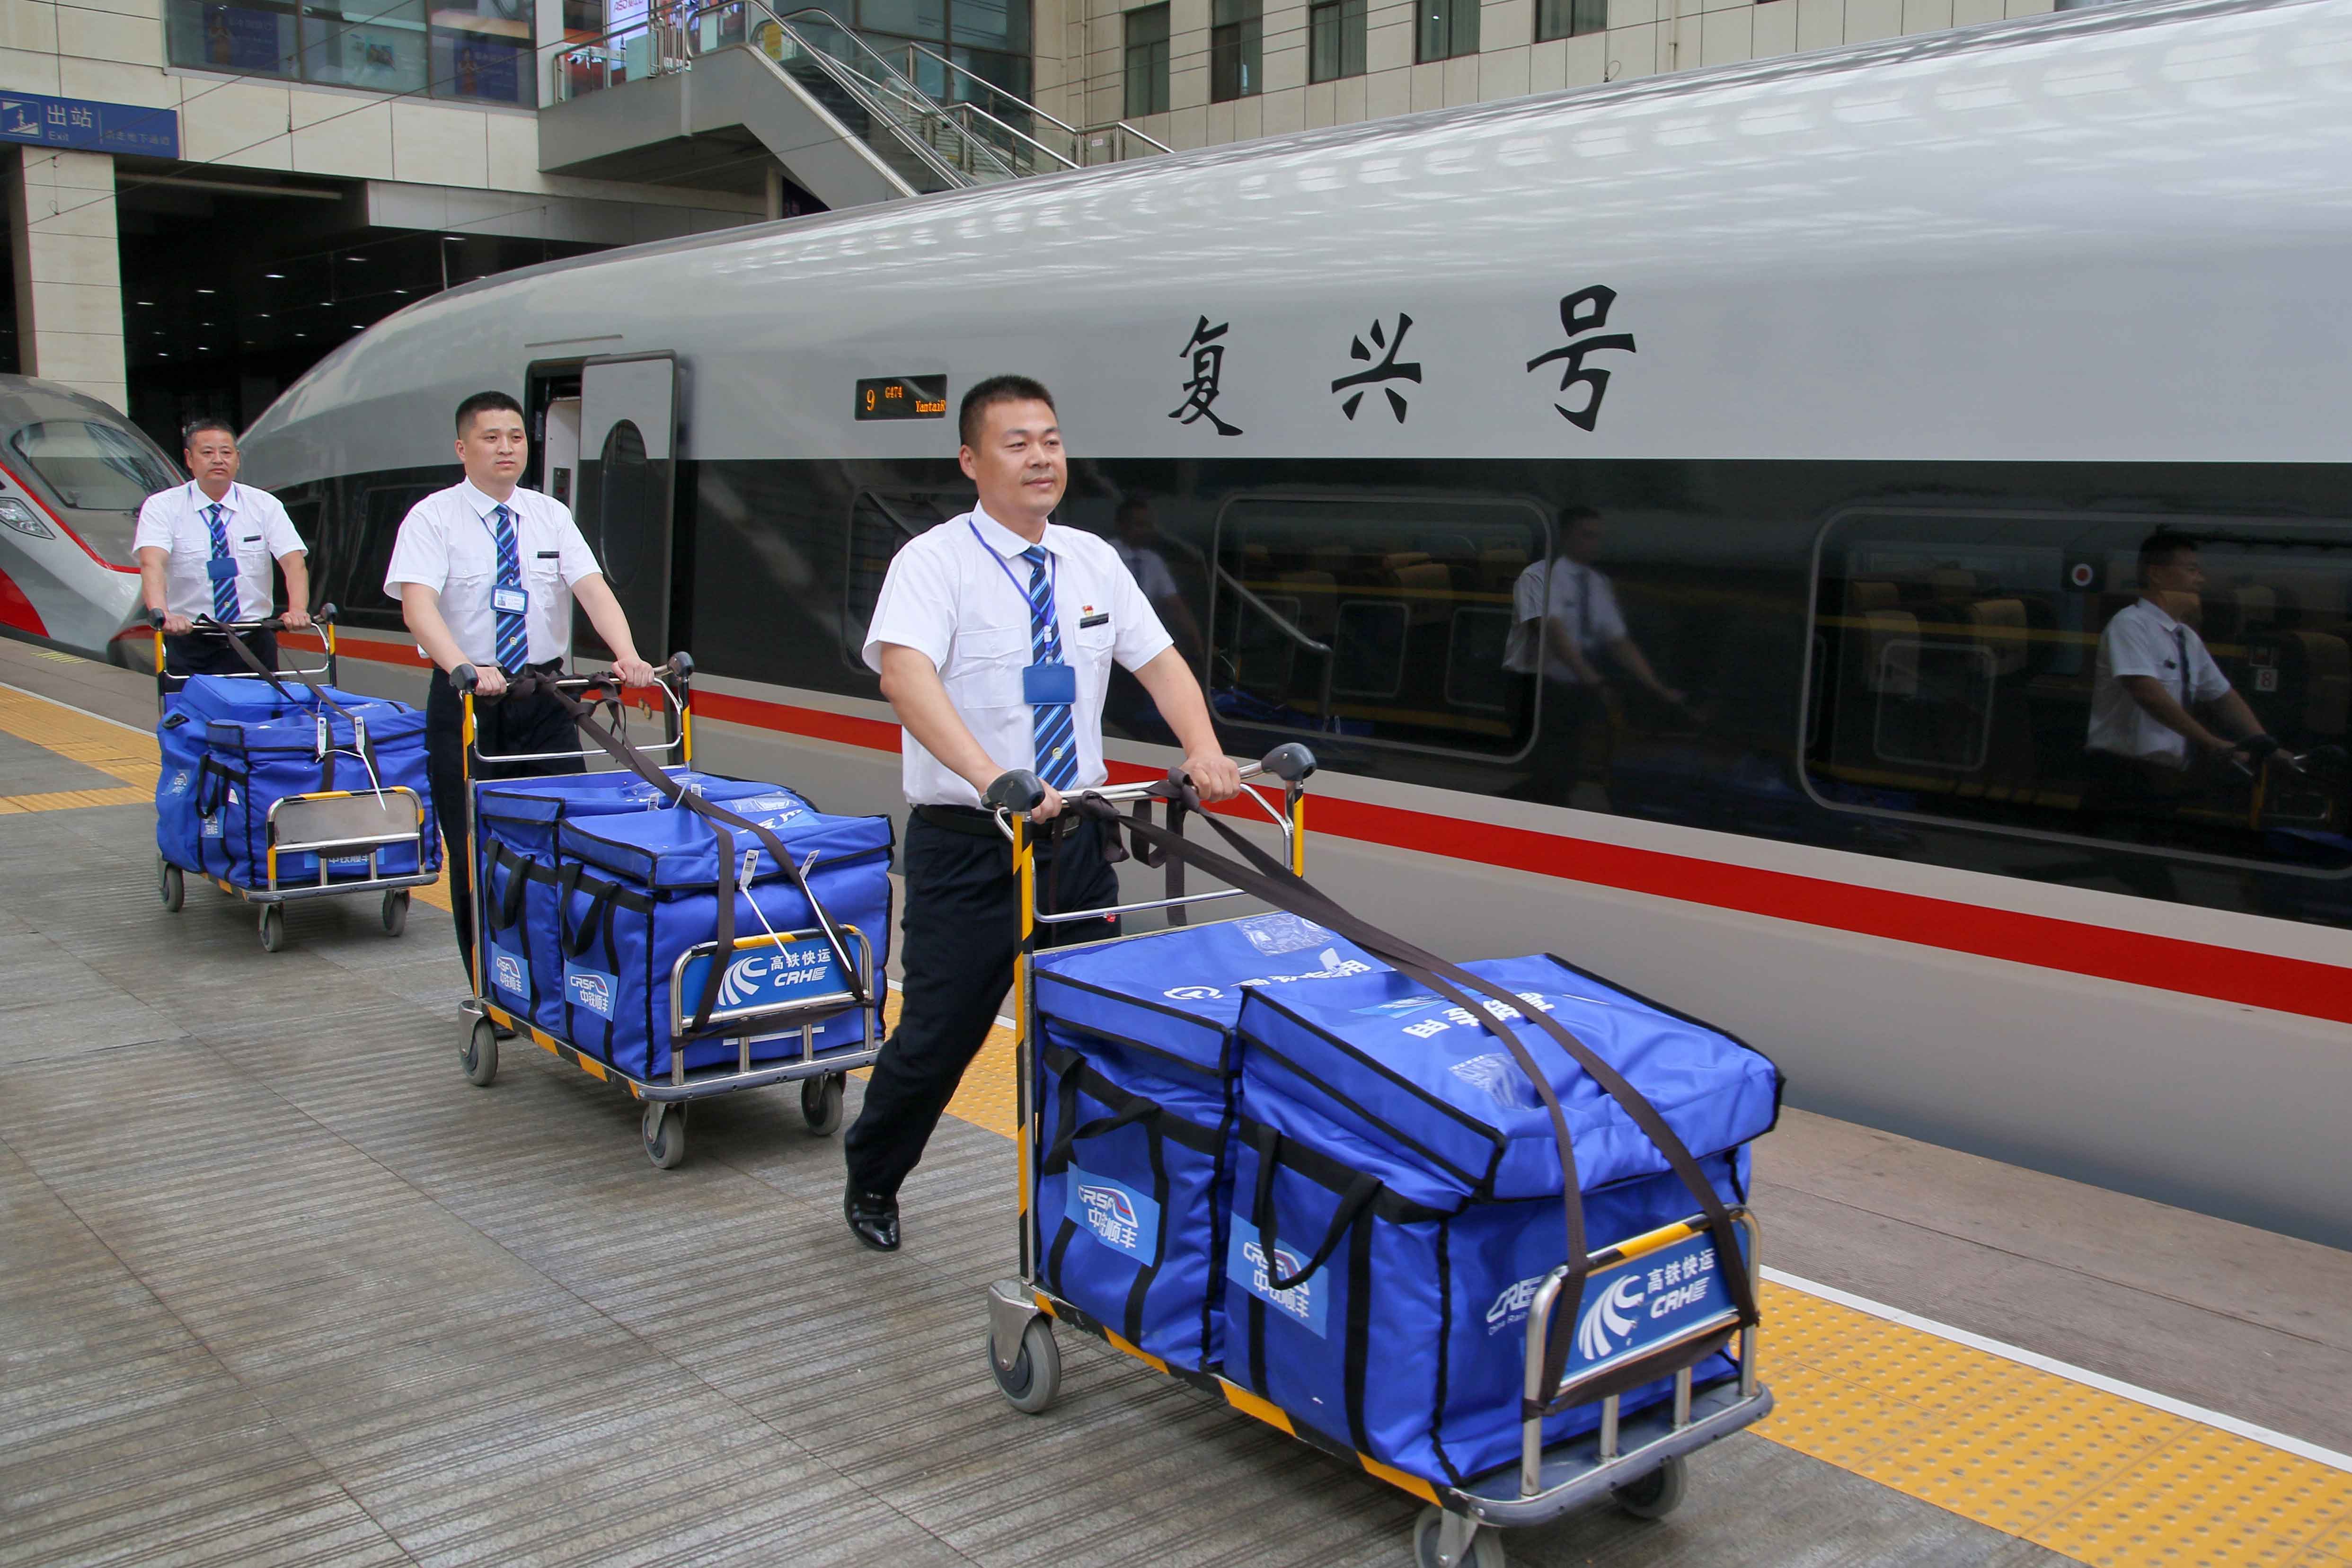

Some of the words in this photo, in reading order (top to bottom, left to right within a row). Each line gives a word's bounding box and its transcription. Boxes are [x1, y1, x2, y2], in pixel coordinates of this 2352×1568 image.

[47, 105, 92, 128] 出站
[49, 131, 69, 141] Exit
[1168, 285, 1636, 435] 复兴号
[867, 390, 875, 411] 9
[885, 386, 903, 399] G474
[770, 948, 831, 971] 高铁快运
[570, 975, 595, 991] CRSF
[774, 966, 828, 987] CRHE
[579, 989, 609, 1012] 中铁顺丰
[1647, 1248, 1715, 1294] 高铁快运
[1650, 1276, 1710, 1319] CRHE
